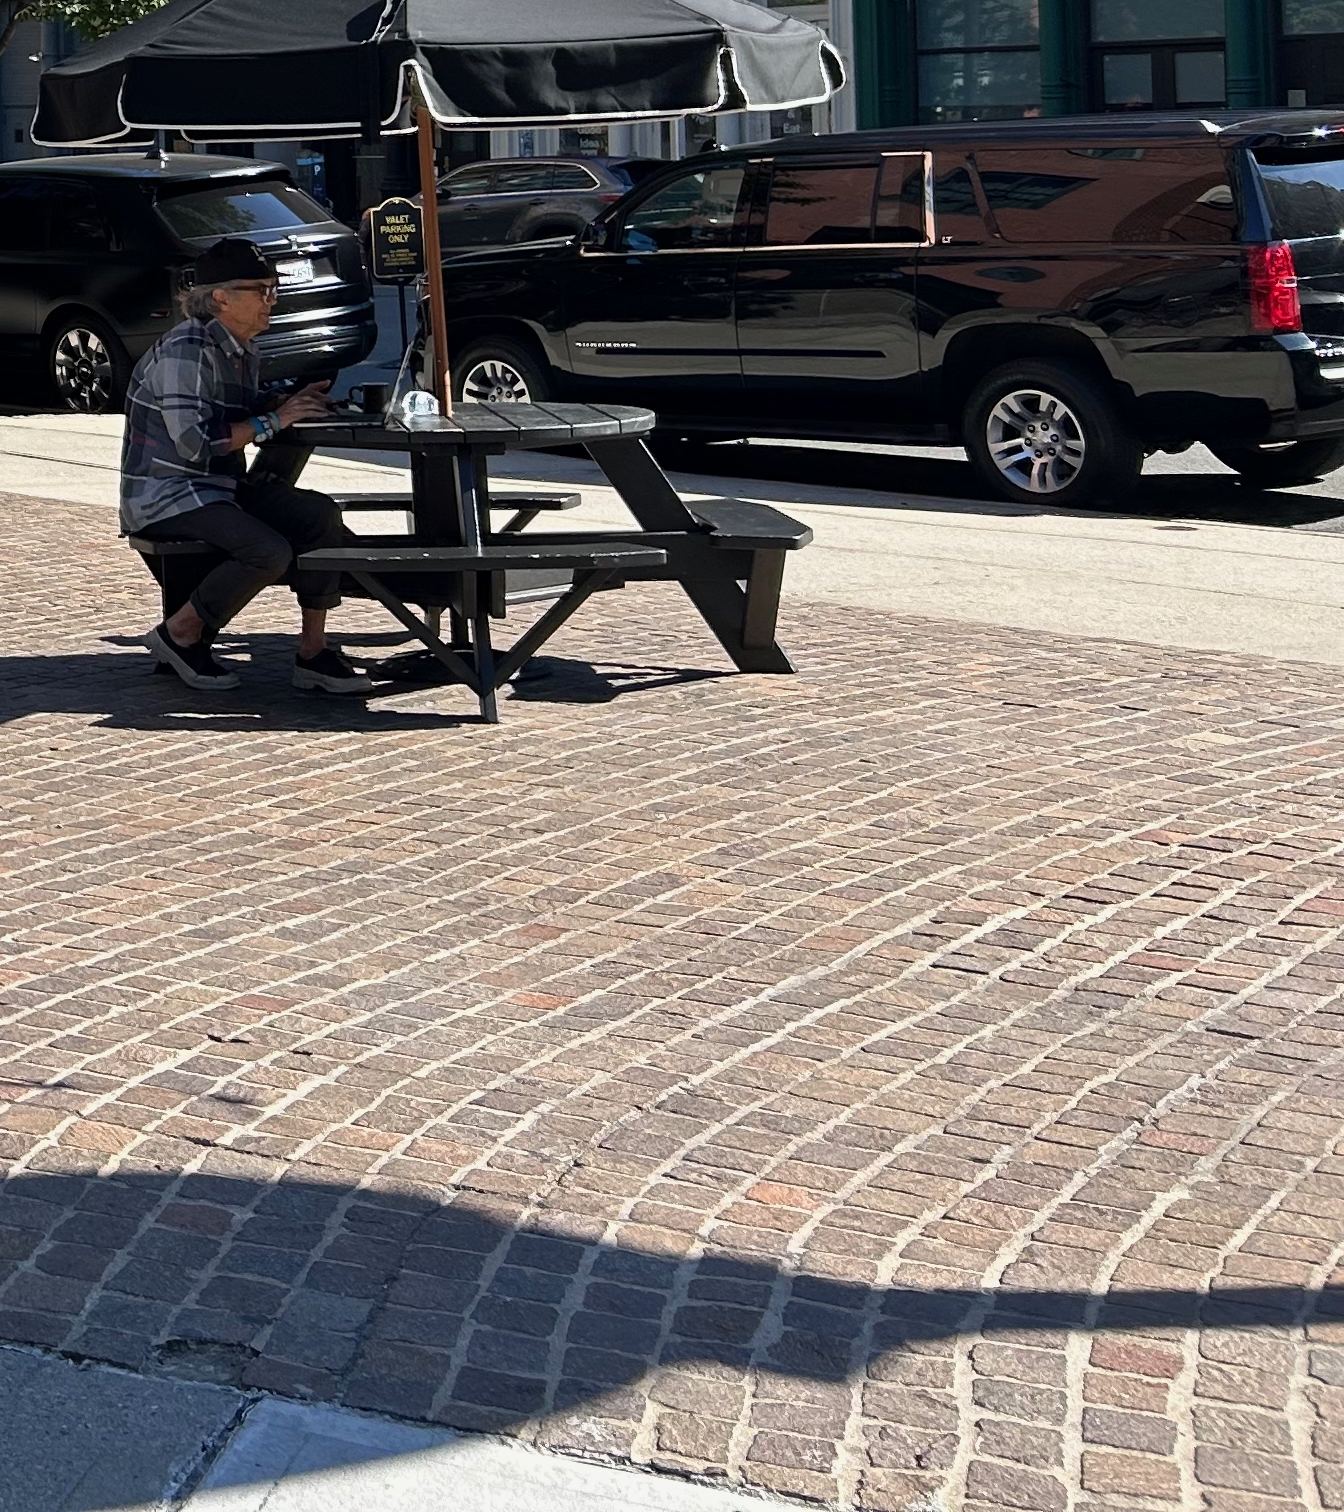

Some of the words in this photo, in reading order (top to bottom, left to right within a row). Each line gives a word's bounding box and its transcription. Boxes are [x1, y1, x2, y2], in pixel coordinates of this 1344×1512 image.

[384, 214, 410, 224] VALET
[379, 223, 417, 234] PARKING
[387, 233, 410, 244] ONLY
